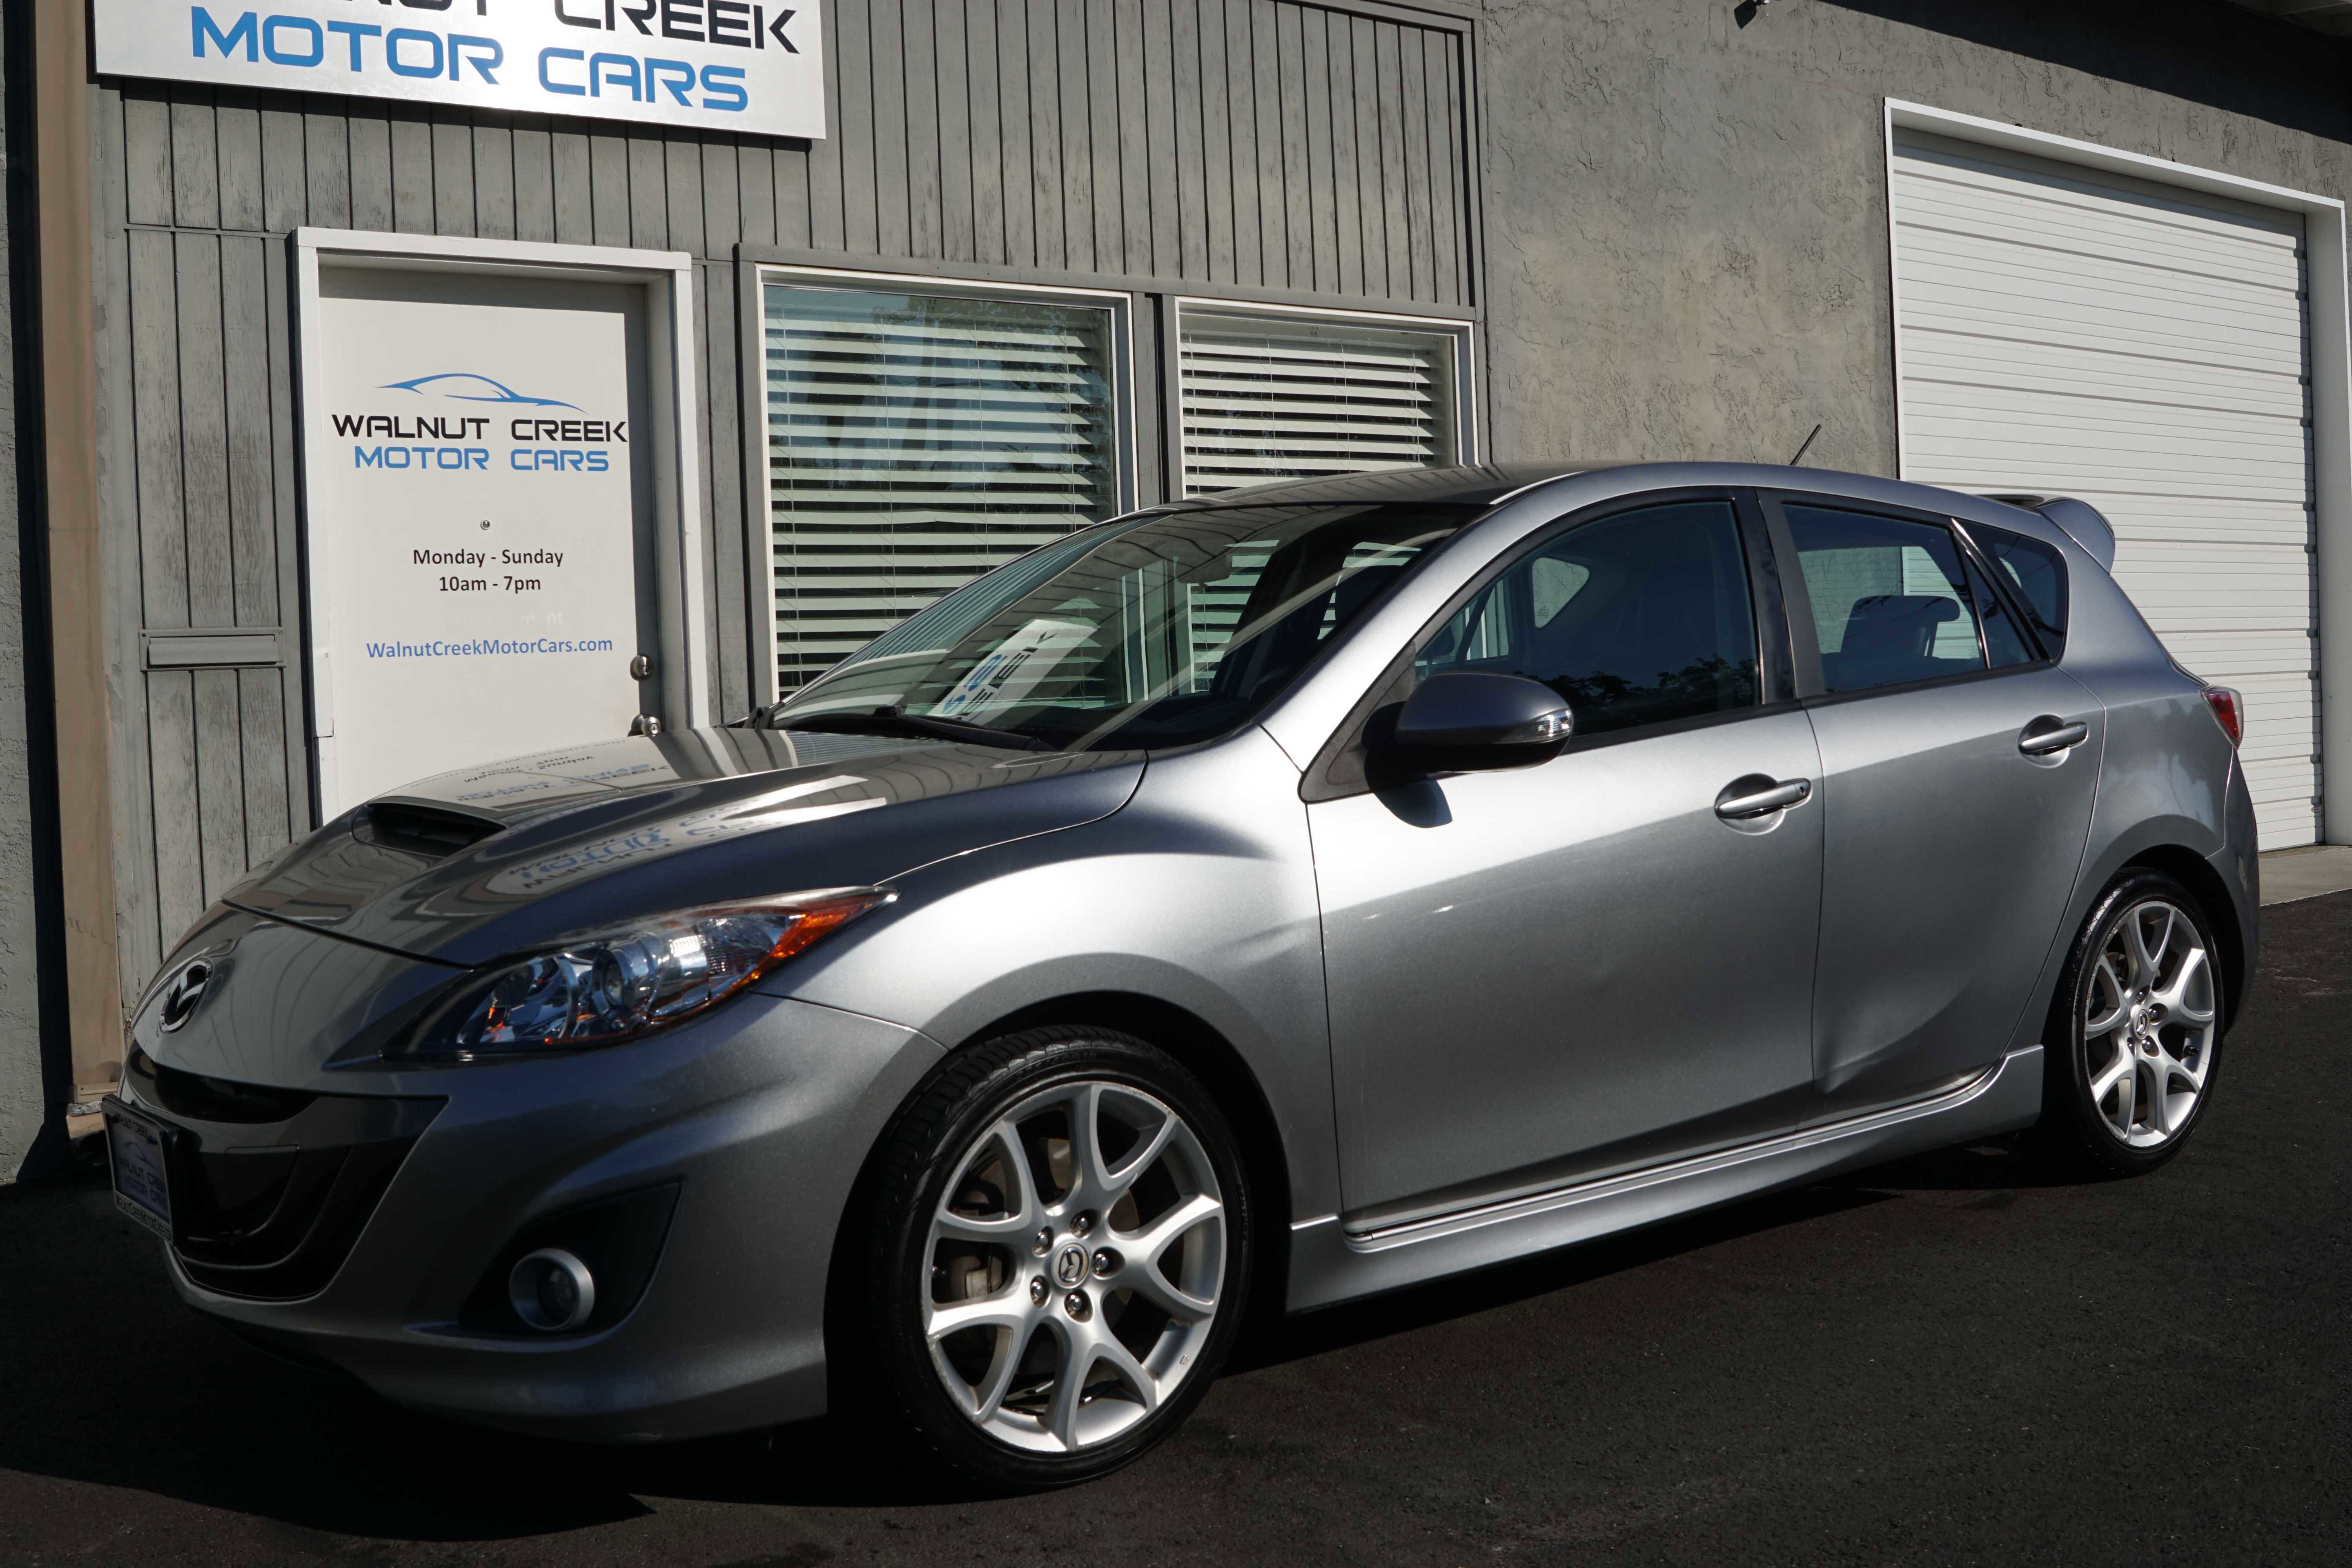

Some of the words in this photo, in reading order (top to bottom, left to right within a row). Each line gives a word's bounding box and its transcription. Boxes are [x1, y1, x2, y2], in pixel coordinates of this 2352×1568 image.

[555, 0, 800, 54] CREEK
[192, 7, 503, 84] MOTOR
[538, 47, 748, 111] CARS
[332, 414, 490, 440] WALNUT
[511, 419, 628, 442] CREEK
[354, 446, 490, 470] MOTOR
[510, 449, 610, 471] CARS
[413, 549, 485, 568] Monday
[502, 548, 563, 567] Sunday
[439, 576, 487, 591] 10am
[503, 576, 541, 594] 7pm
[366, 638, 613, 658] WalnutCreekMotorCars.com
